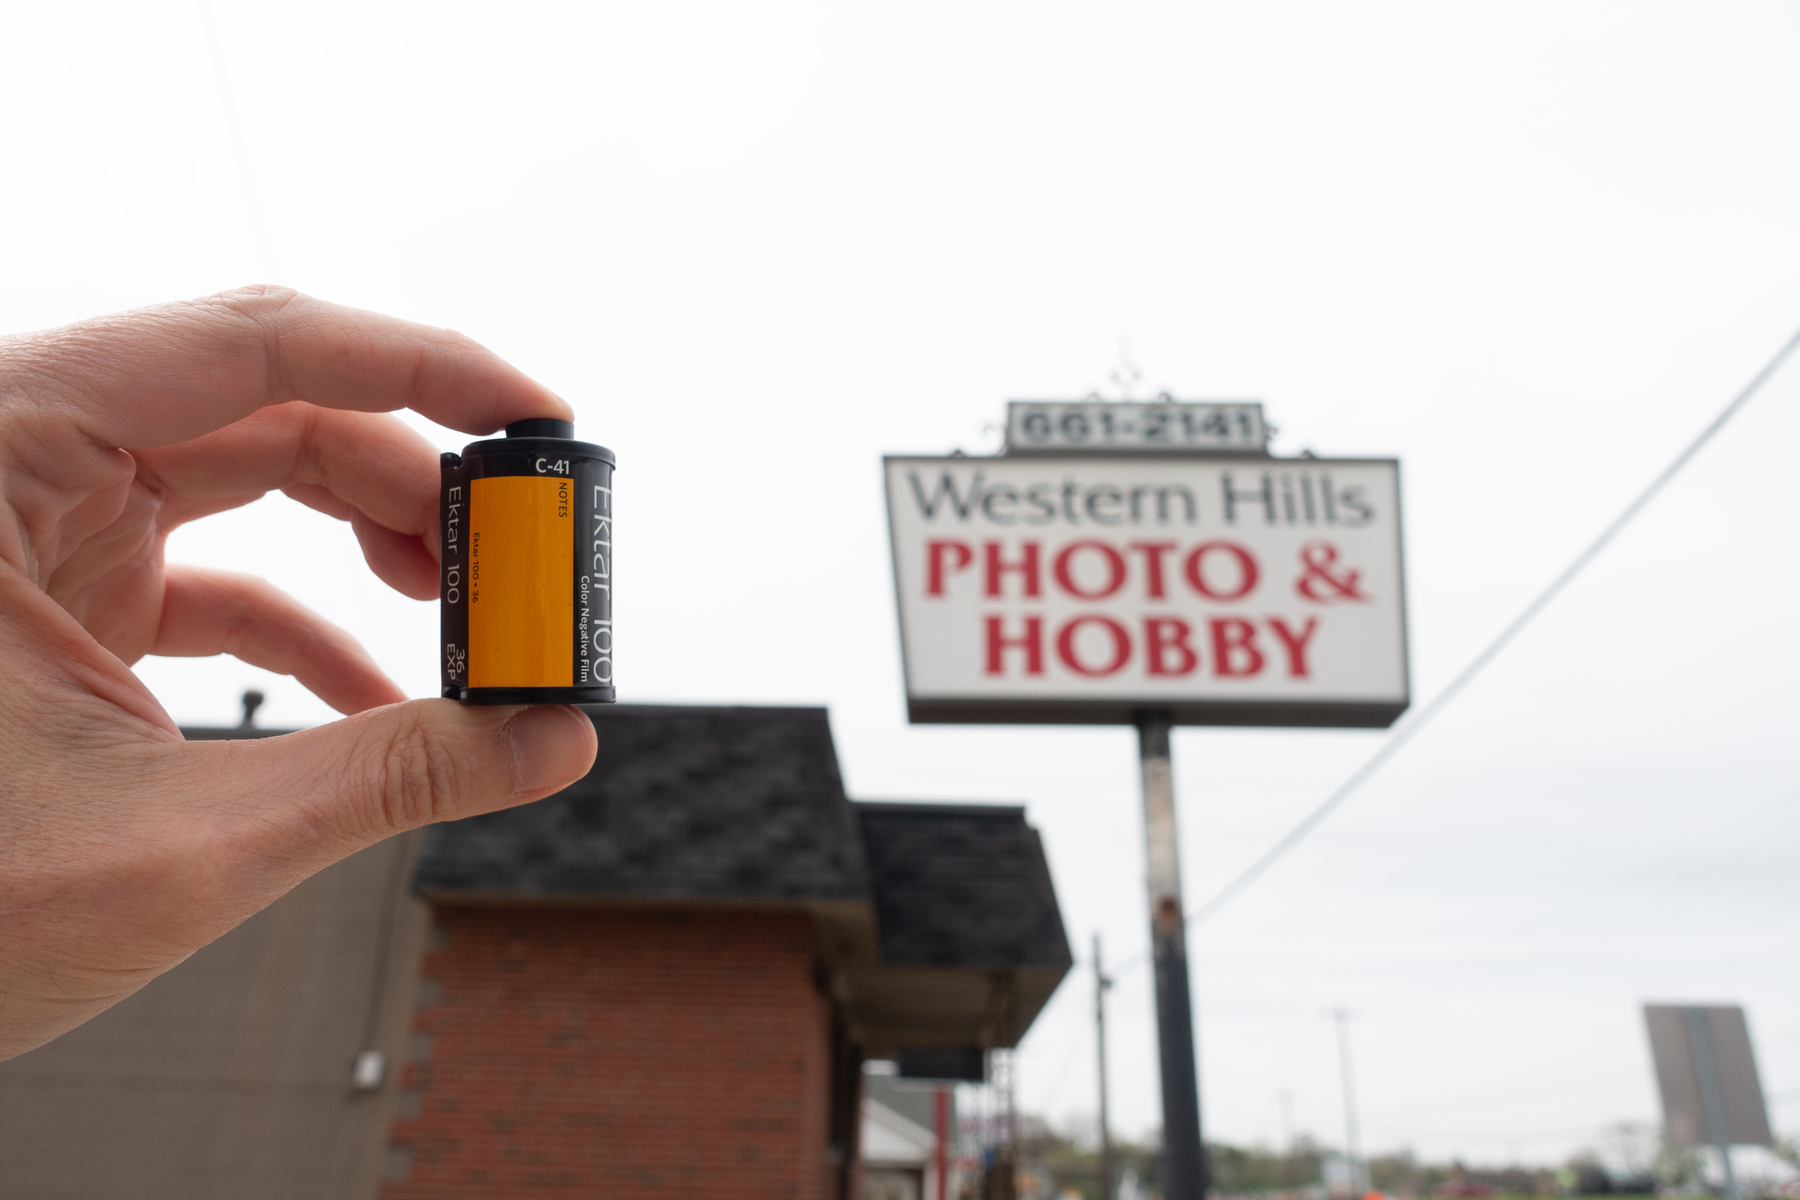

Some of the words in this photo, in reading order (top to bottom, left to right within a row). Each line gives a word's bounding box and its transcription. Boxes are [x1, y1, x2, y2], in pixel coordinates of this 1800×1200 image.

[1022, 411, 1255, 444] 661-2141
[535, 458, 570, 475] C-41
[558, 482, 568, 518] NOTES
[908, 470, 1196, 526] Western
[1222, 472, 1376, 527] Hills
[448, 486, 462, 554] Ektar
[472, 532, 480, 559] Ektar
[593, 484, 613, 601] Ektar
[447, 564, 460, 604] 100
[925, 538, 1259, 600] PHOTO
[1294, 539, 1373, 603] &
[472, 590, 479, 604] 36
[580, 575, 590, 606] Color
[579, 607, 590, 656] Negative
[983, 613, 1318, 680] HOBBY
[446, 644, 456, 680] EXP
[455, 649, 465, 674] 36
[593, 618, 613, 684] 100
[580, 659, 590, 683] Film
